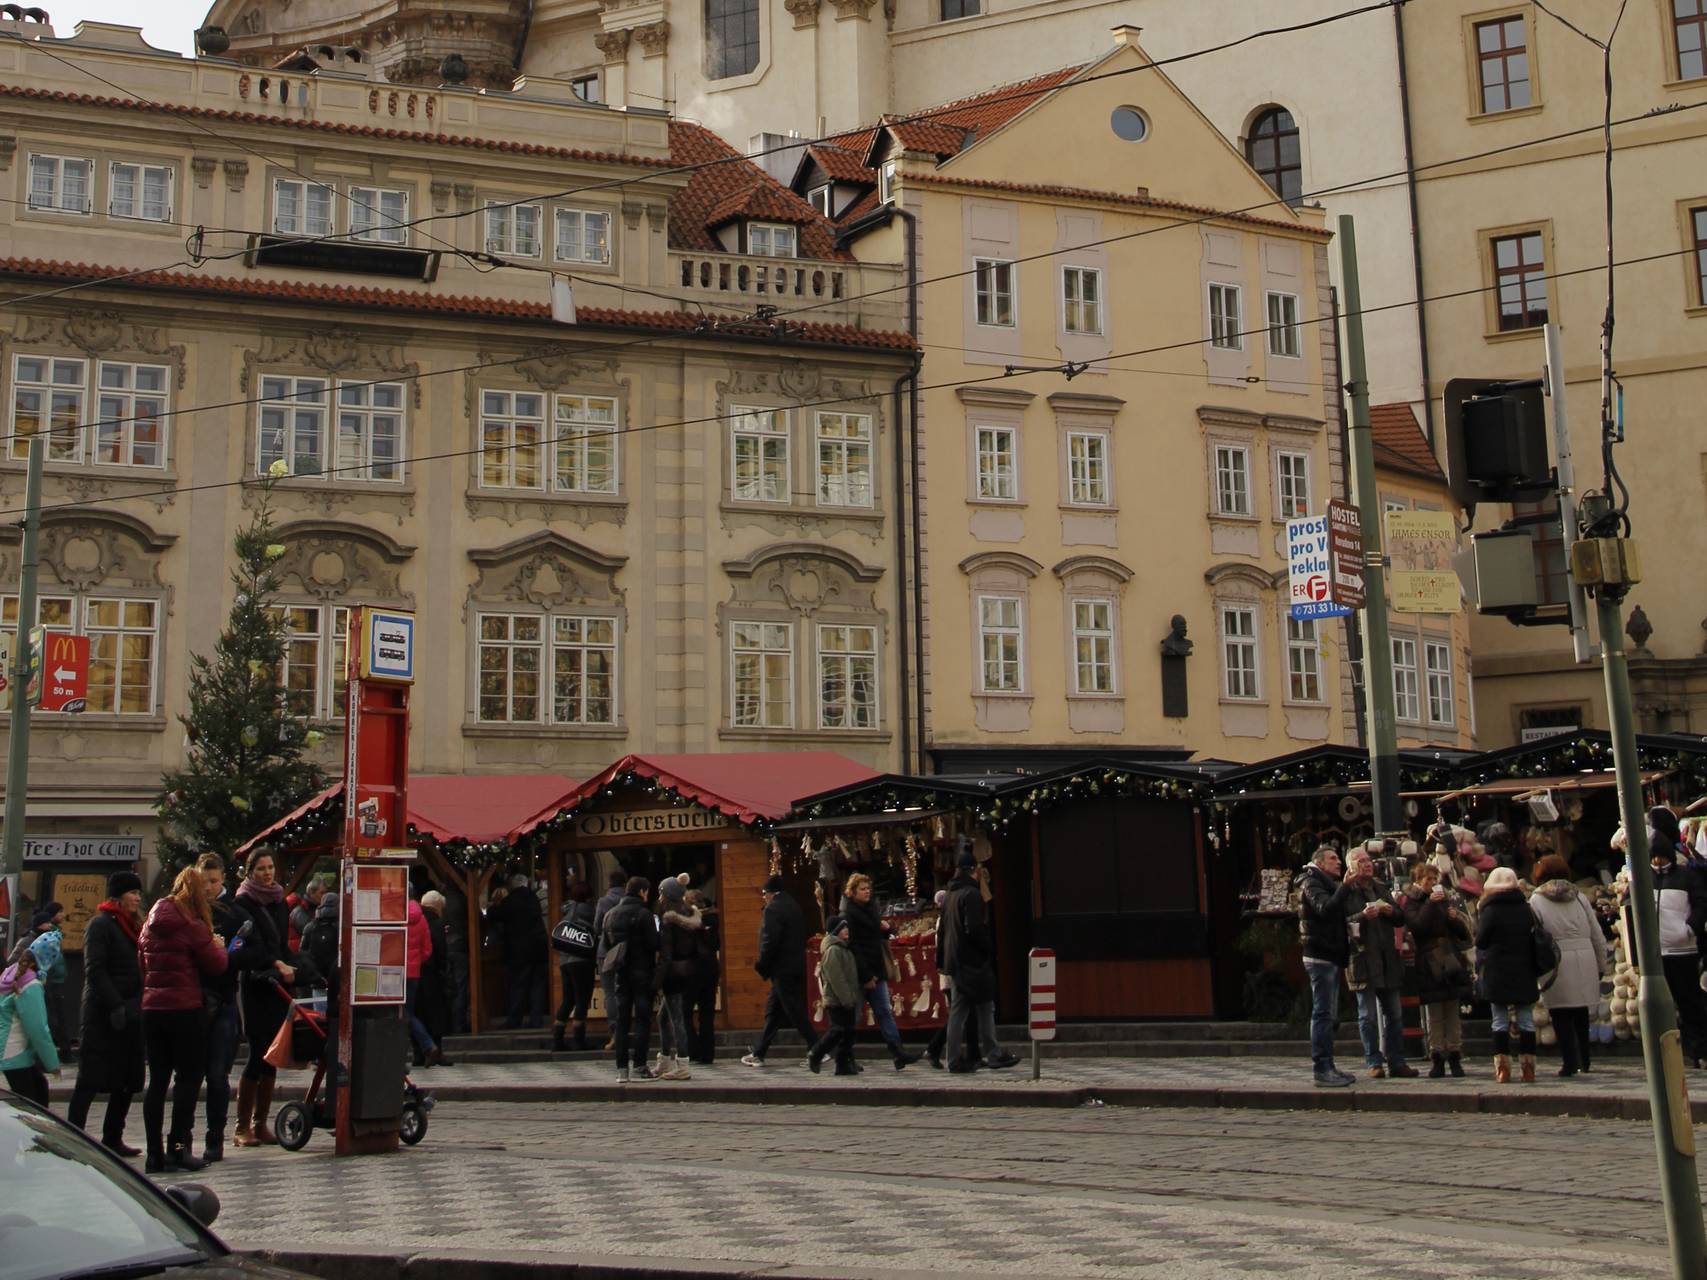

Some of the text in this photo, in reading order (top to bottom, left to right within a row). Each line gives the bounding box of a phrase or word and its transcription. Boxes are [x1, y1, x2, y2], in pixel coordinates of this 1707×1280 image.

[1331, 505, 1360, 526] HOSTEL
[1392, 528, 1450, 540] JAMES ENSOR
[1291, 536, 1329, 560] pro V
[1292, 557, 1330, 575] rekla
[1303, 604, 1316, 615] 731
[1318, 602, 1328, 613] 33
[53, 687, 64, 695] 50
[561, 926, 588, 943] NIKE
